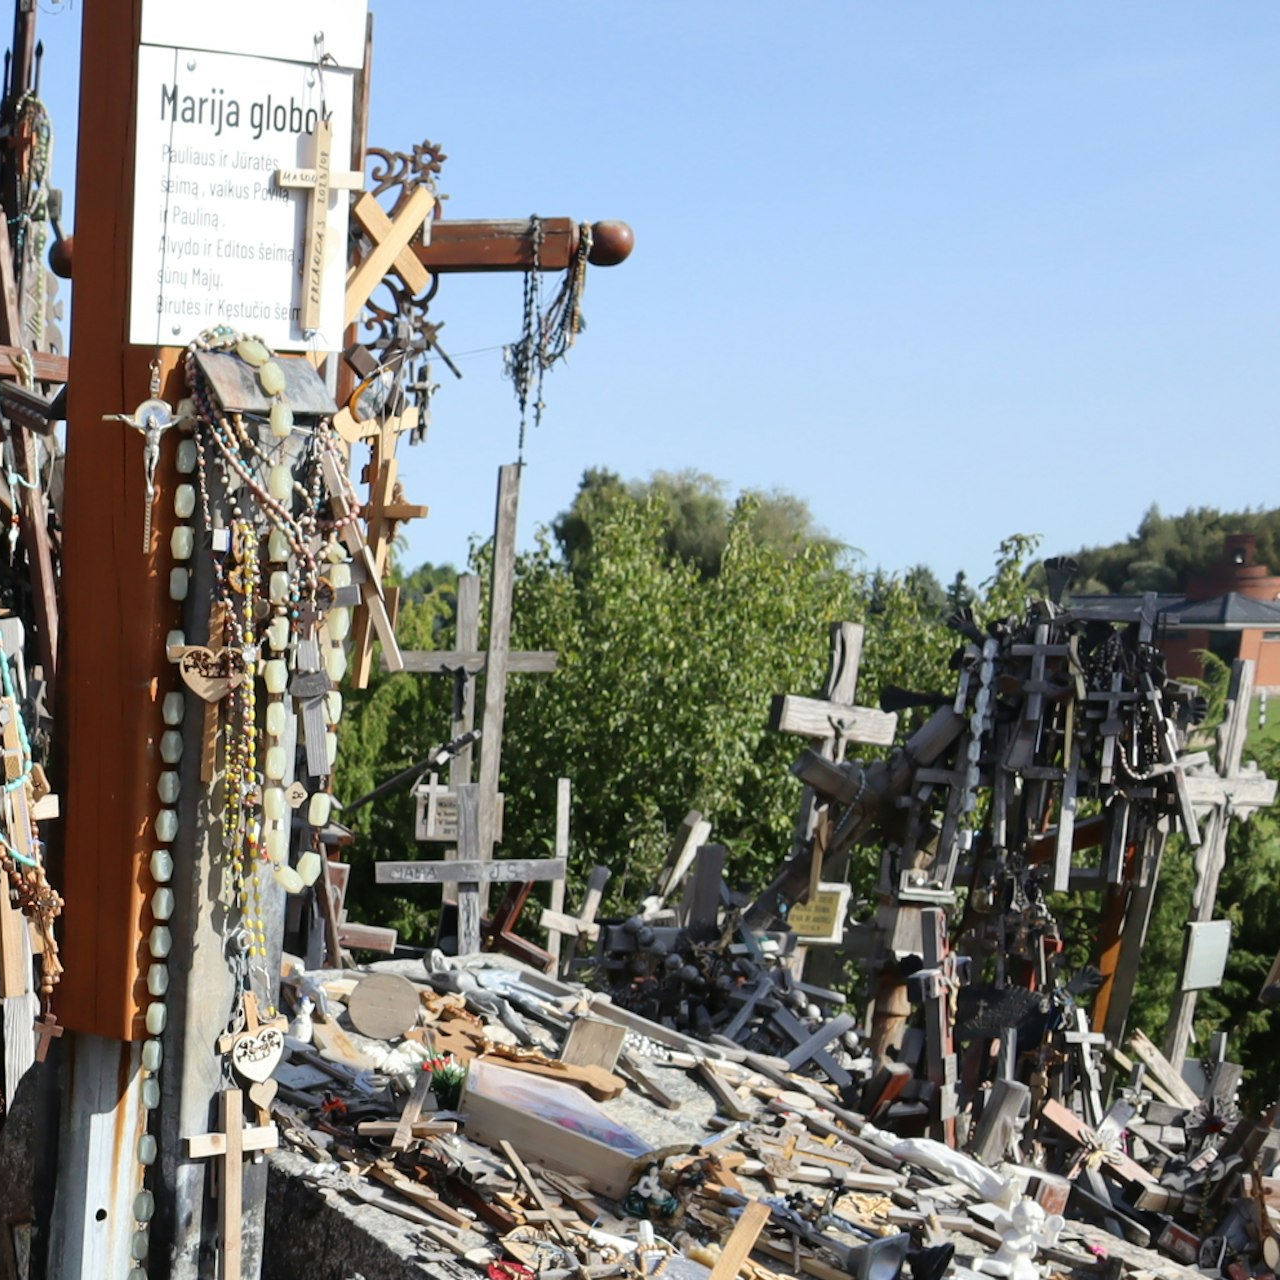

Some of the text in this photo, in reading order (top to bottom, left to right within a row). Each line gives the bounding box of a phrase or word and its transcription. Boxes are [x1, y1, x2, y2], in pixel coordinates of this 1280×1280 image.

[160, 83, 240, 139] Marija
[162, 144, 280, 172] Pauliaus ir Jūratės
[160, 179, 289, 207] šeimą vaikus Povilą
[159, 207, 219, 231] ir Pauliną
[158, 236, 294, 267] Alvydo ir Editos šeimą
[157, 267, 187, 289] sūnų
[156, 295, 301, 321] Birutės ir Kęstučio šeim
